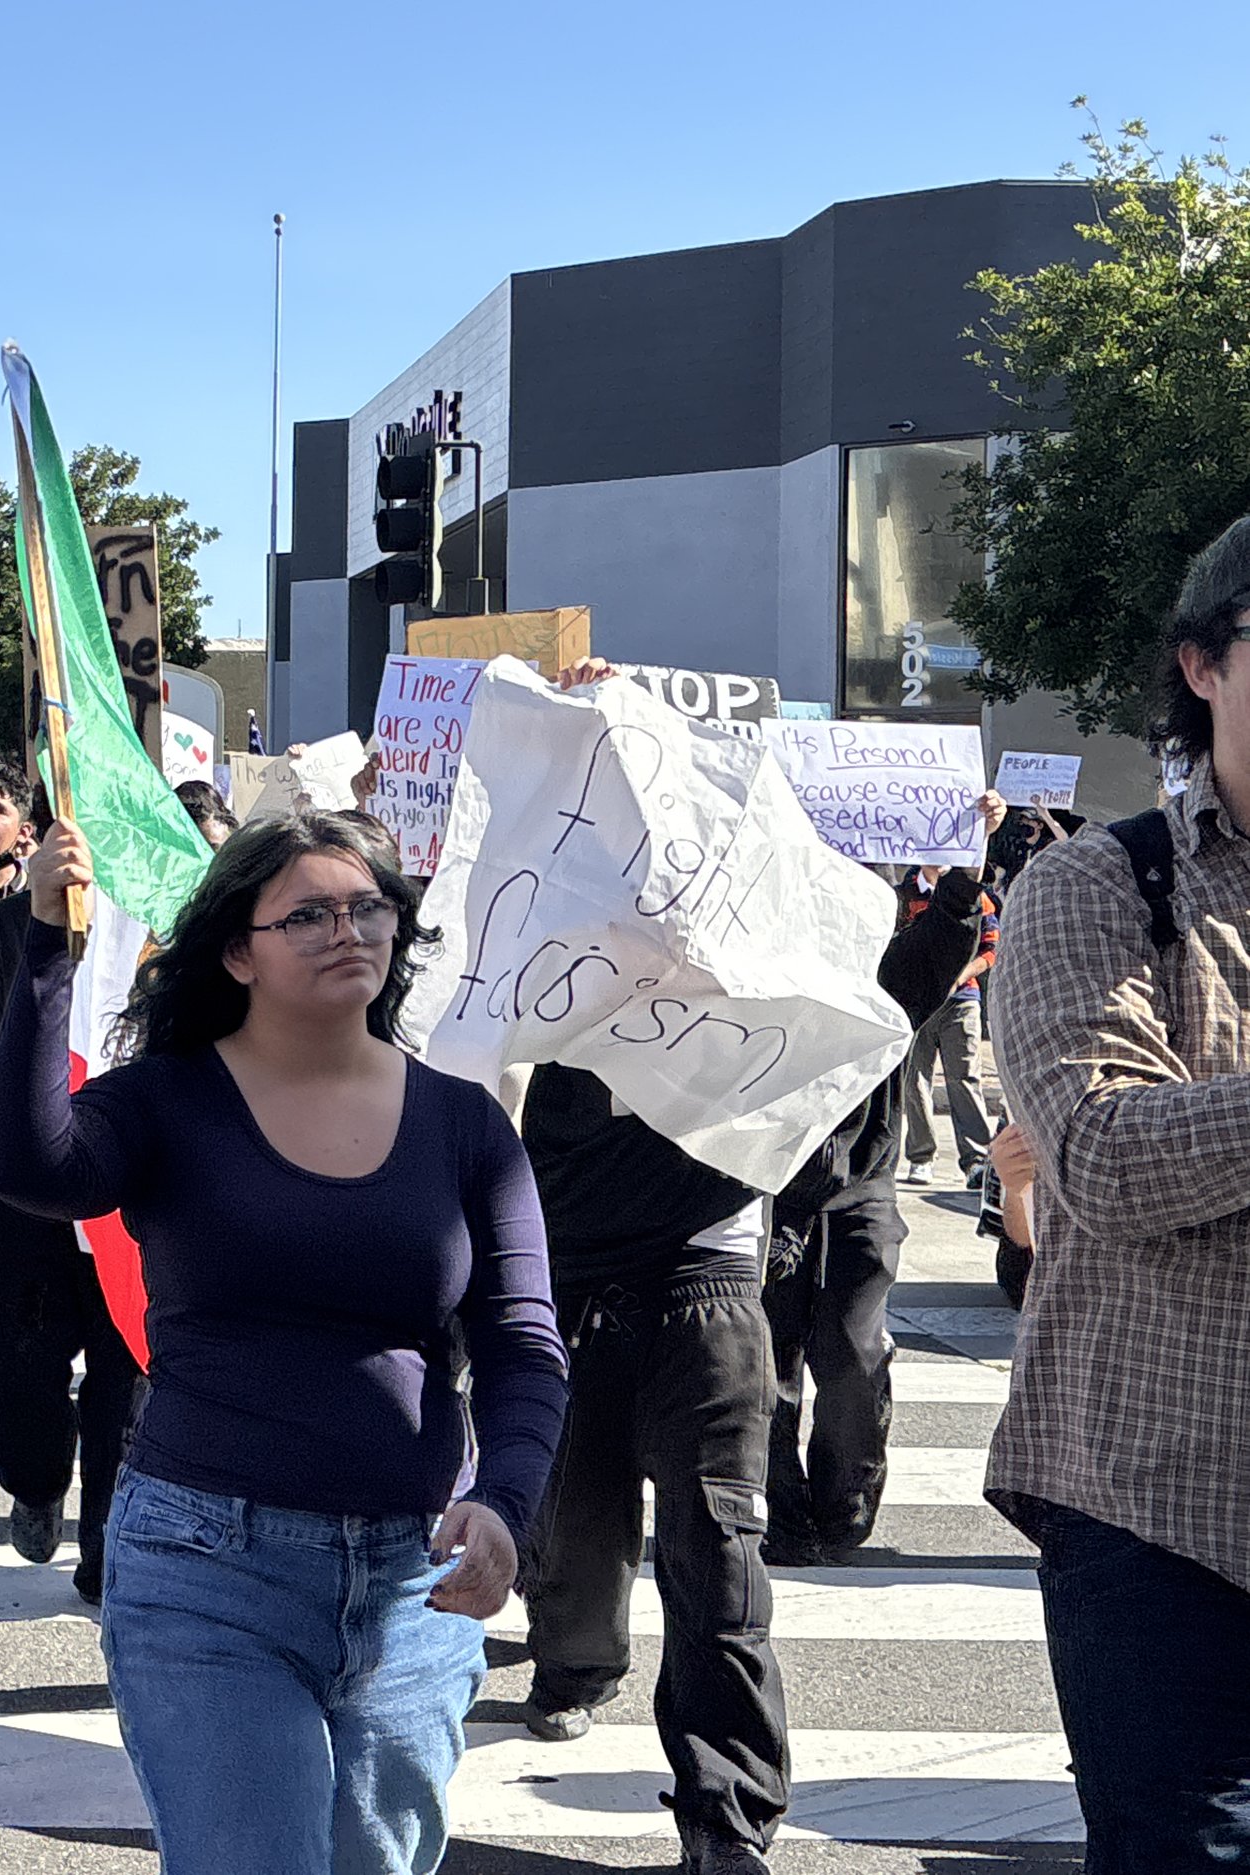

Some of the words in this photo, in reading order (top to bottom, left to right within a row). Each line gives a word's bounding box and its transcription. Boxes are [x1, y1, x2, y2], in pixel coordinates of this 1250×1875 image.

[390, 661, 457, 703] Time
[900, 621, 924, 707] 502
[618, 664, 760, 720] TOP
[378, 714, 421, 745] are
[829, 727, 947, 764] Personal
[1004, 757, 1051, 771] PEOPLE
[406, 780, 454, 808] night
[790, 781, 882, 803] ecause
[553, 725, 774, 948] fight
[871, 805, 908, 832] for
[916, 807, 976, 849] YOU
